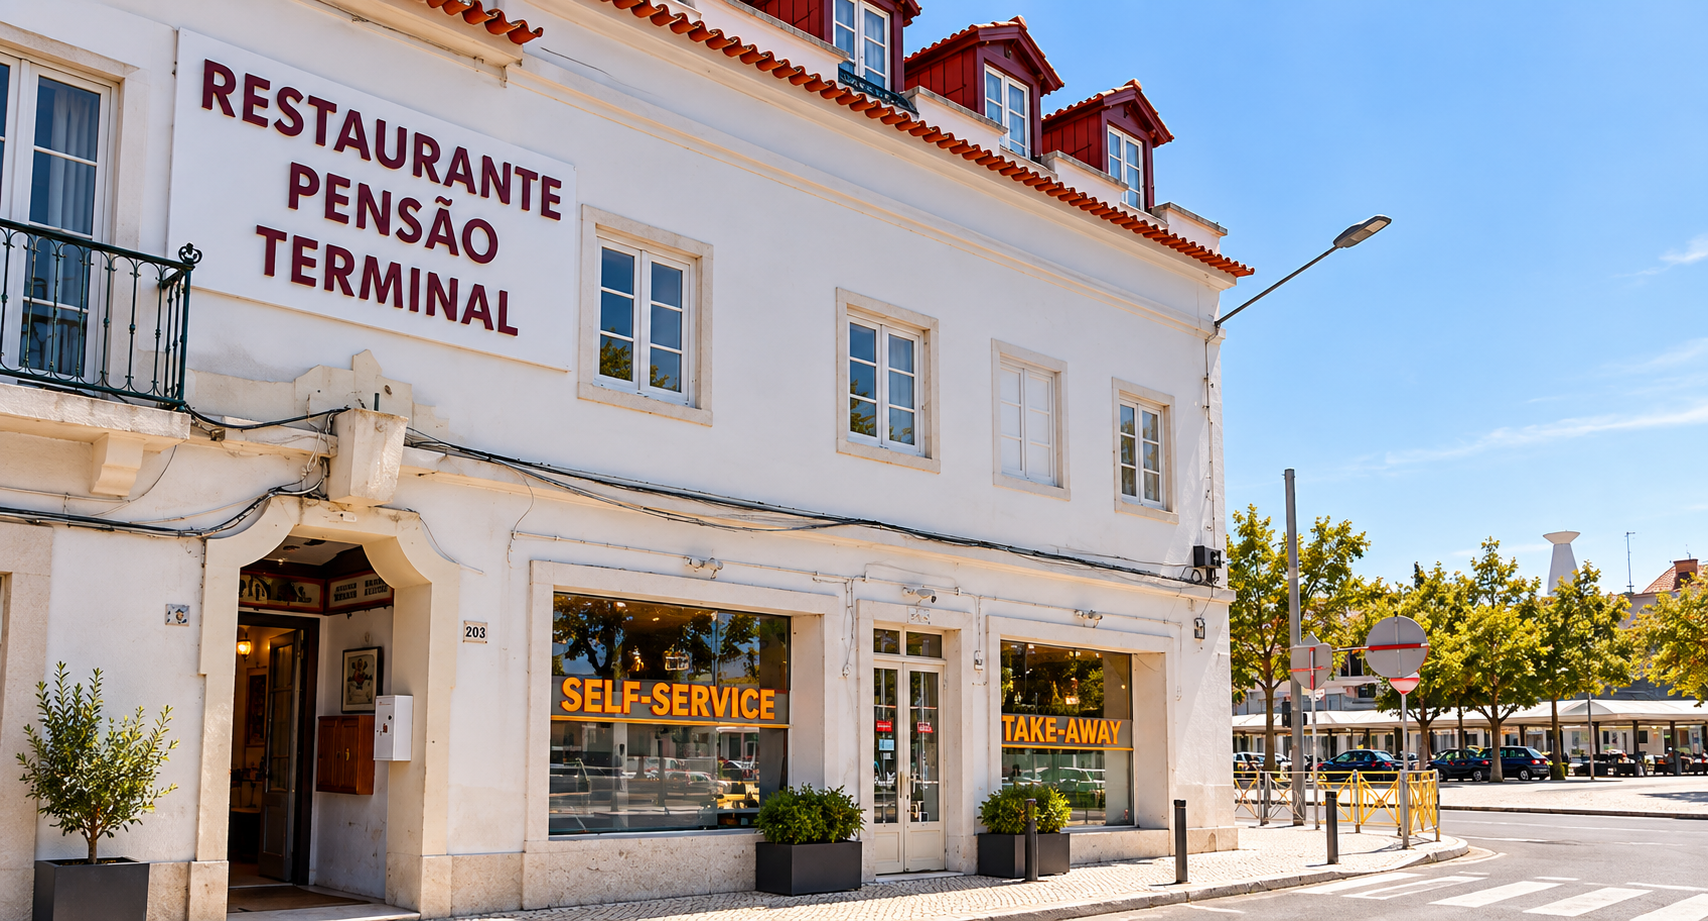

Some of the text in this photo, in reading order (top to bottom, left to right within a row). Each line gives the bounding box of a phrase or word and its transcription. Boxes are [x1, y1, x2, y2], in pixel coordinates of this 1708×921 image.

[201, 58, 562, 221] RESTAURANTE
[288, 162, 499, 264] PENSÃO
[256, 225, 519, 337] TERMINAL
[465, 625, 486, 639] 203
[561, 676, 776, 720] SELF-SERVICE
[1001, 715, 1122, 745] TAKE-AWAY
